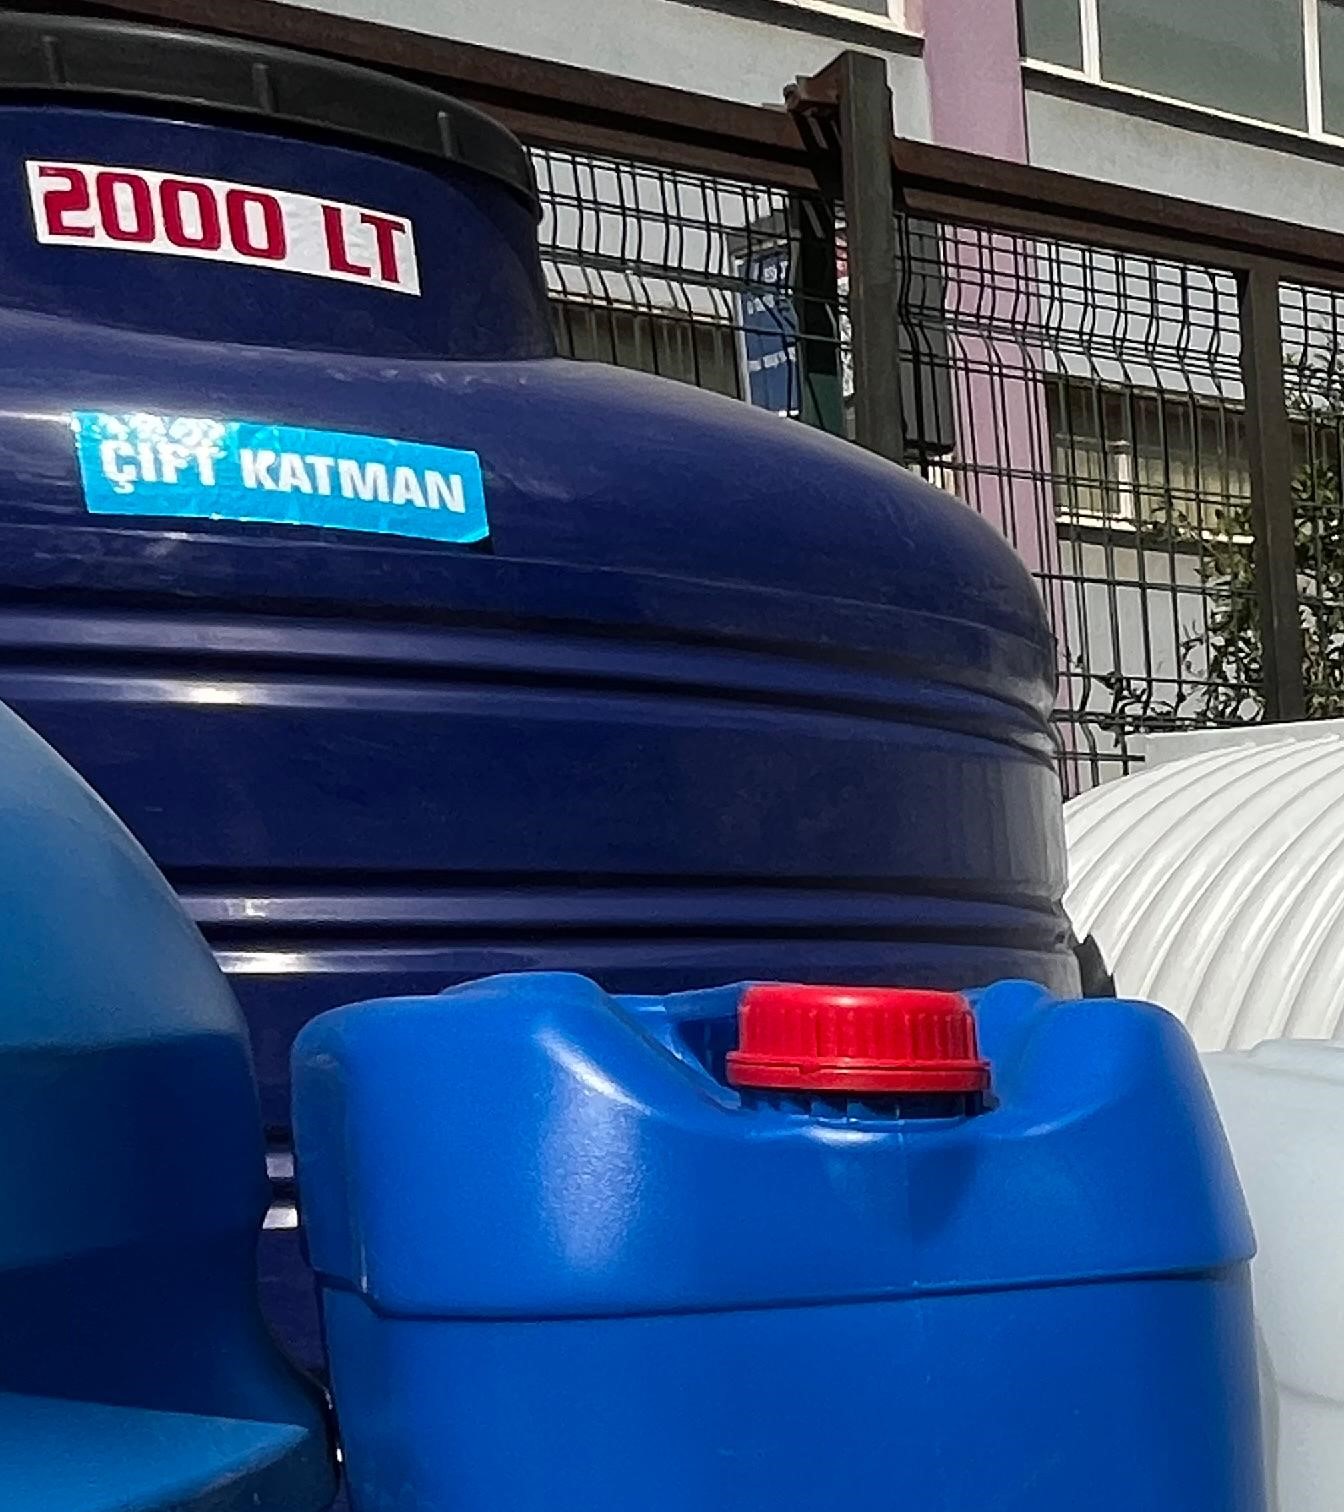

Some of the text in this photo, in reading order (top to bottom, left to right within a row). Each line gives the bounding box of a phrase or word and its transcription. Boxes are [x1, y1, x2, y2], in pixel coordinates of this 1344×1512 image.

[38, 165, 406, 284] 2000 LT
[239, 447, 466, 514] KATMAN
